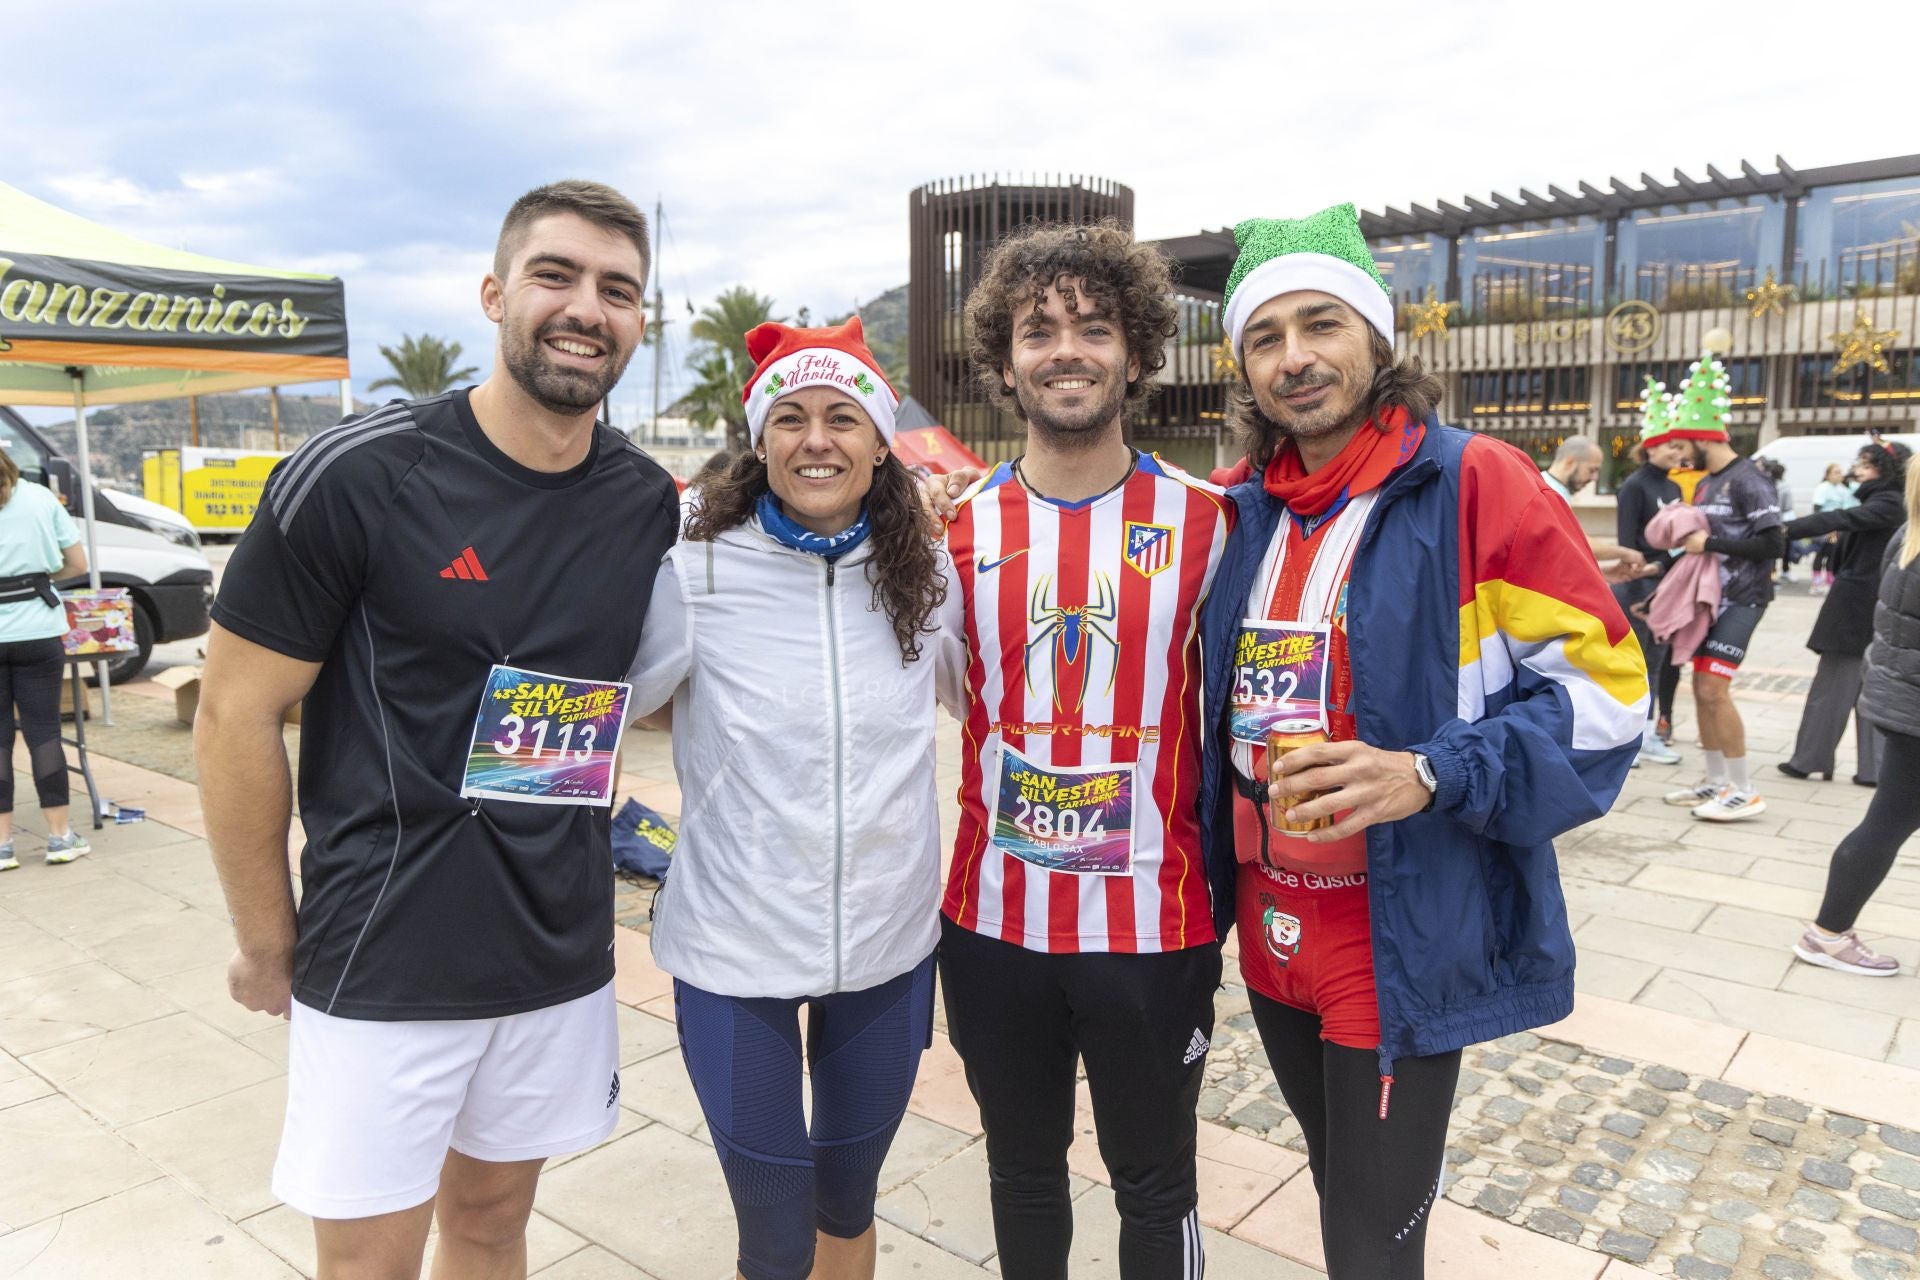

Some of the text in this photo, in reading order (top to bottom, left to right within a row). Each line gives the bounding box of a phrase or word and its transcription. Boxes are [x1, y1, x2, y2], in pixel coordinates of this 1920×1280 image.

[1514, 319, 1592, 346] SHOP
[1615, 312, 1651, 341] 43
[797, 355, 840, 372] Feliz
[785, 369, 854, 388] Navidad
[1256, 652, 1313, 669] CARTAGENA
[514, 683, 566, 700] SAN
[510, 688, 617, 717] SILVESTRE
[559, 706, 612, 723] CARTAGENA
[494, 714, 597, 763] 3113
[1021, 773, 1120, 803] SILVESTRE
[1022, 770, 1056, 790] SAN
[1058, 789, 1119, 809] CARTAGENA
[1014, 795, 1107, 841] 2804
[1028, 836, 1083, 853] PABLO SAX
[1183, 1039, 1210, 1064] adidas
